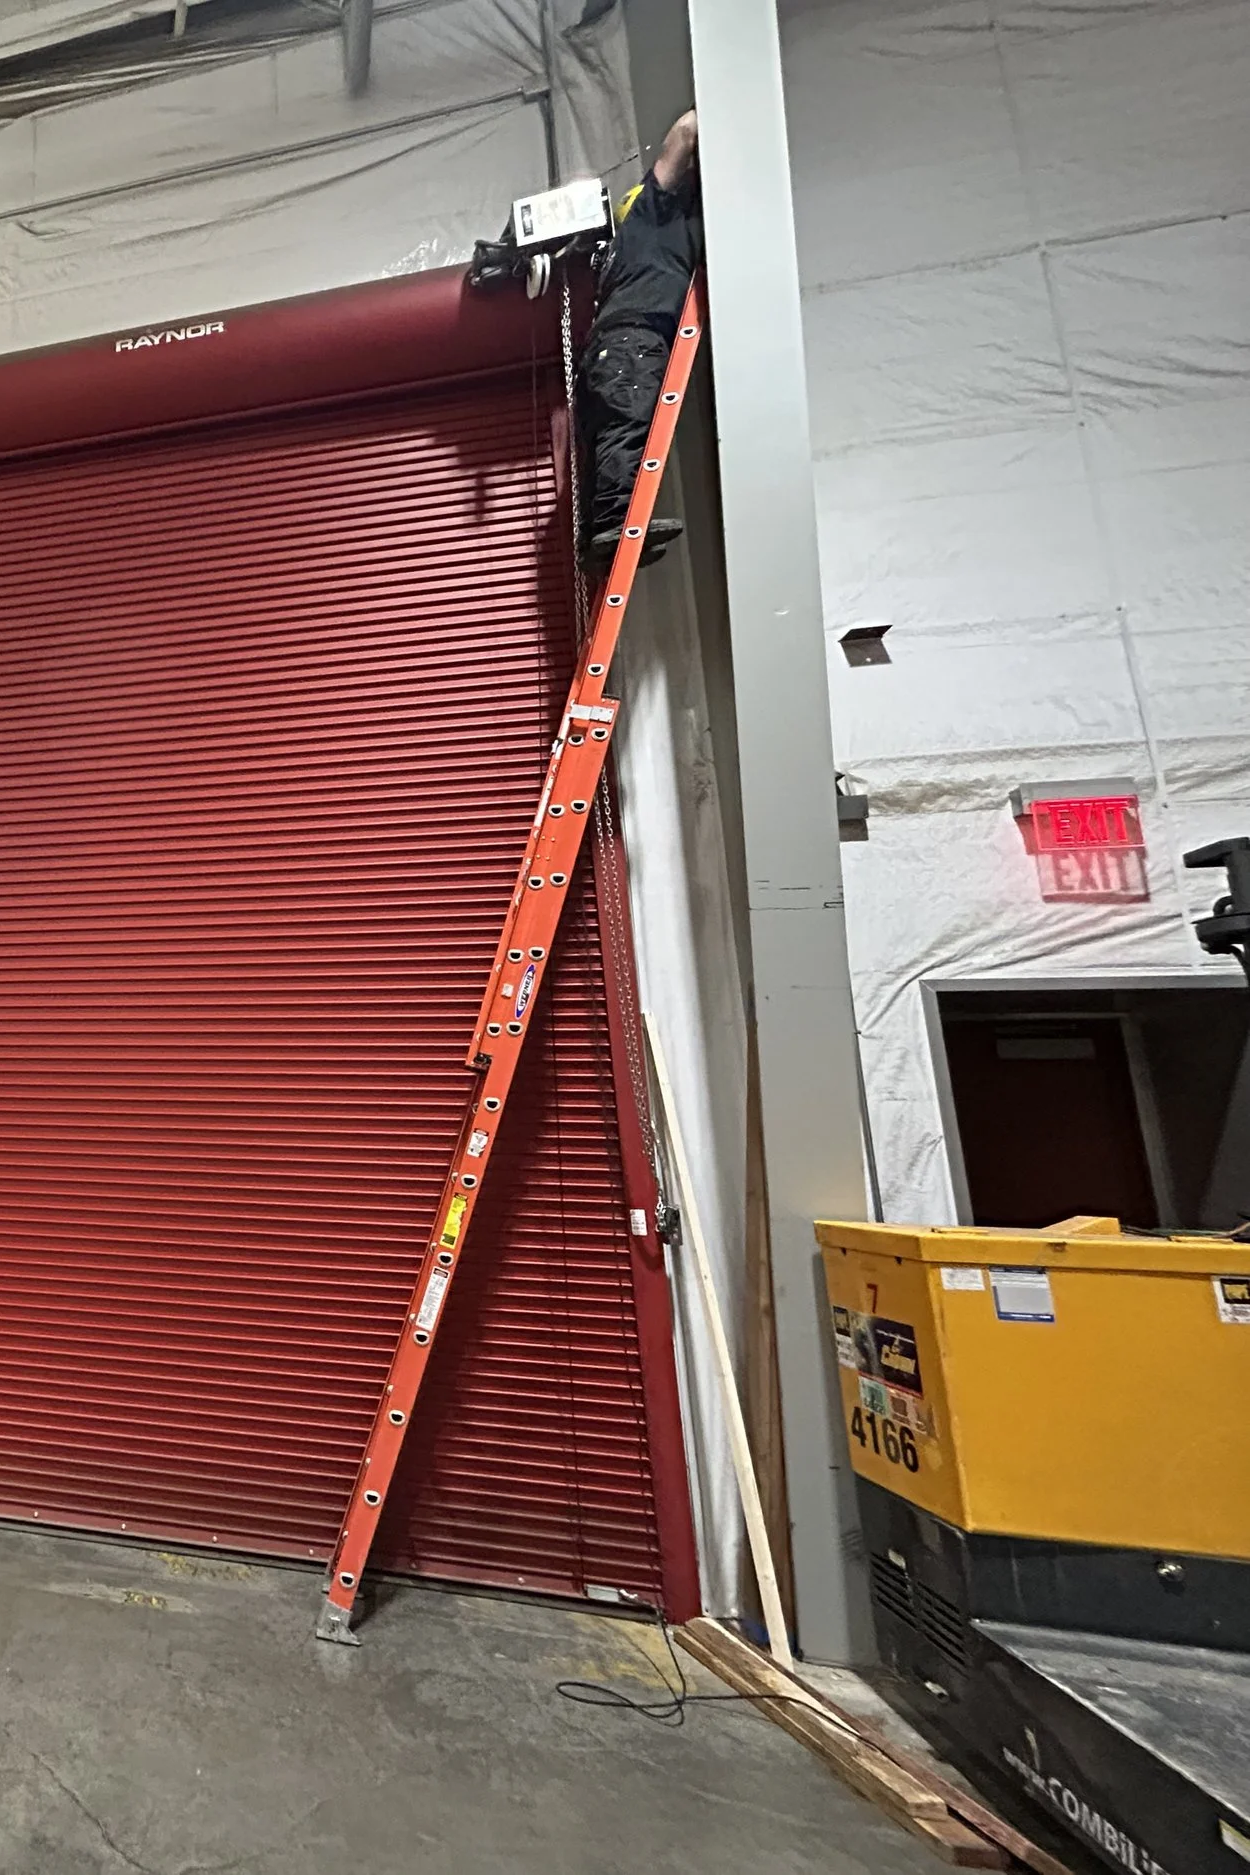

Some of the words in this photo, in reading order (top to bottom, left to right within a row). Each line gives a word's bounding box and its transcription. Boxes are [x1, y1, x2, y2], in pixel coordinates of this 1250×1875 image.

[115, 321, 225, 353] RAYNOR
[1049, 801, 1129, 844] EXIT
[1051, 849, 1131, 892] EXIT
[866, 1282, 879, 1314] 7
[851, 1406, 919, 1473] 4166
